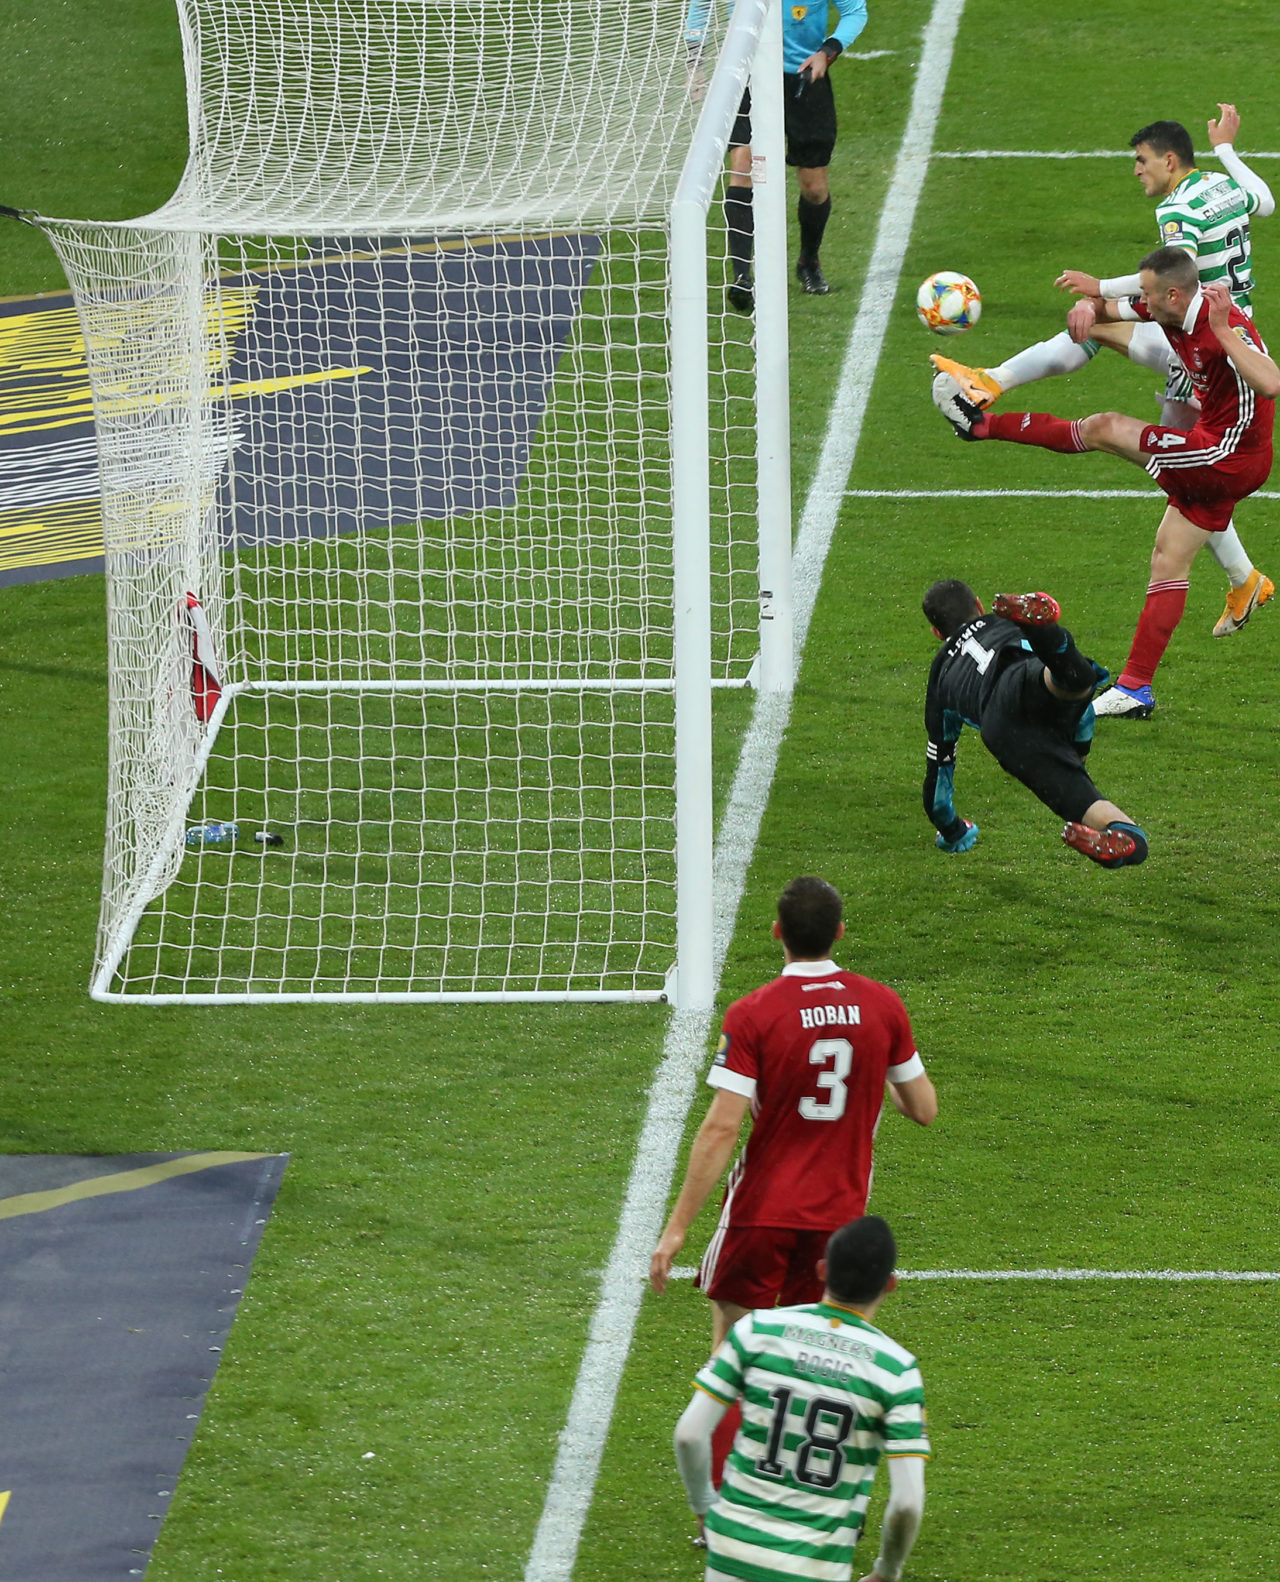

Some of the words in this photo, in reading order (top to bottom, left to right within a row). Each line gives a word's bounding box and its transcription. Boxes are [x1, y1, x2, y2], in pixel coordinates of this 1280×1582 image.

[1157, 433, 1186, 448] 4
[961, 636, 996, 676] 1
[800, 1005, 861, 1029] HOBAN
[798, 1038, 854, 1121] 3
[783, 1325, 876, 1362] MAGNERS
[795, 1351, 853, 1383] ROGIC
[755, 1384, 858, 1492] 18
